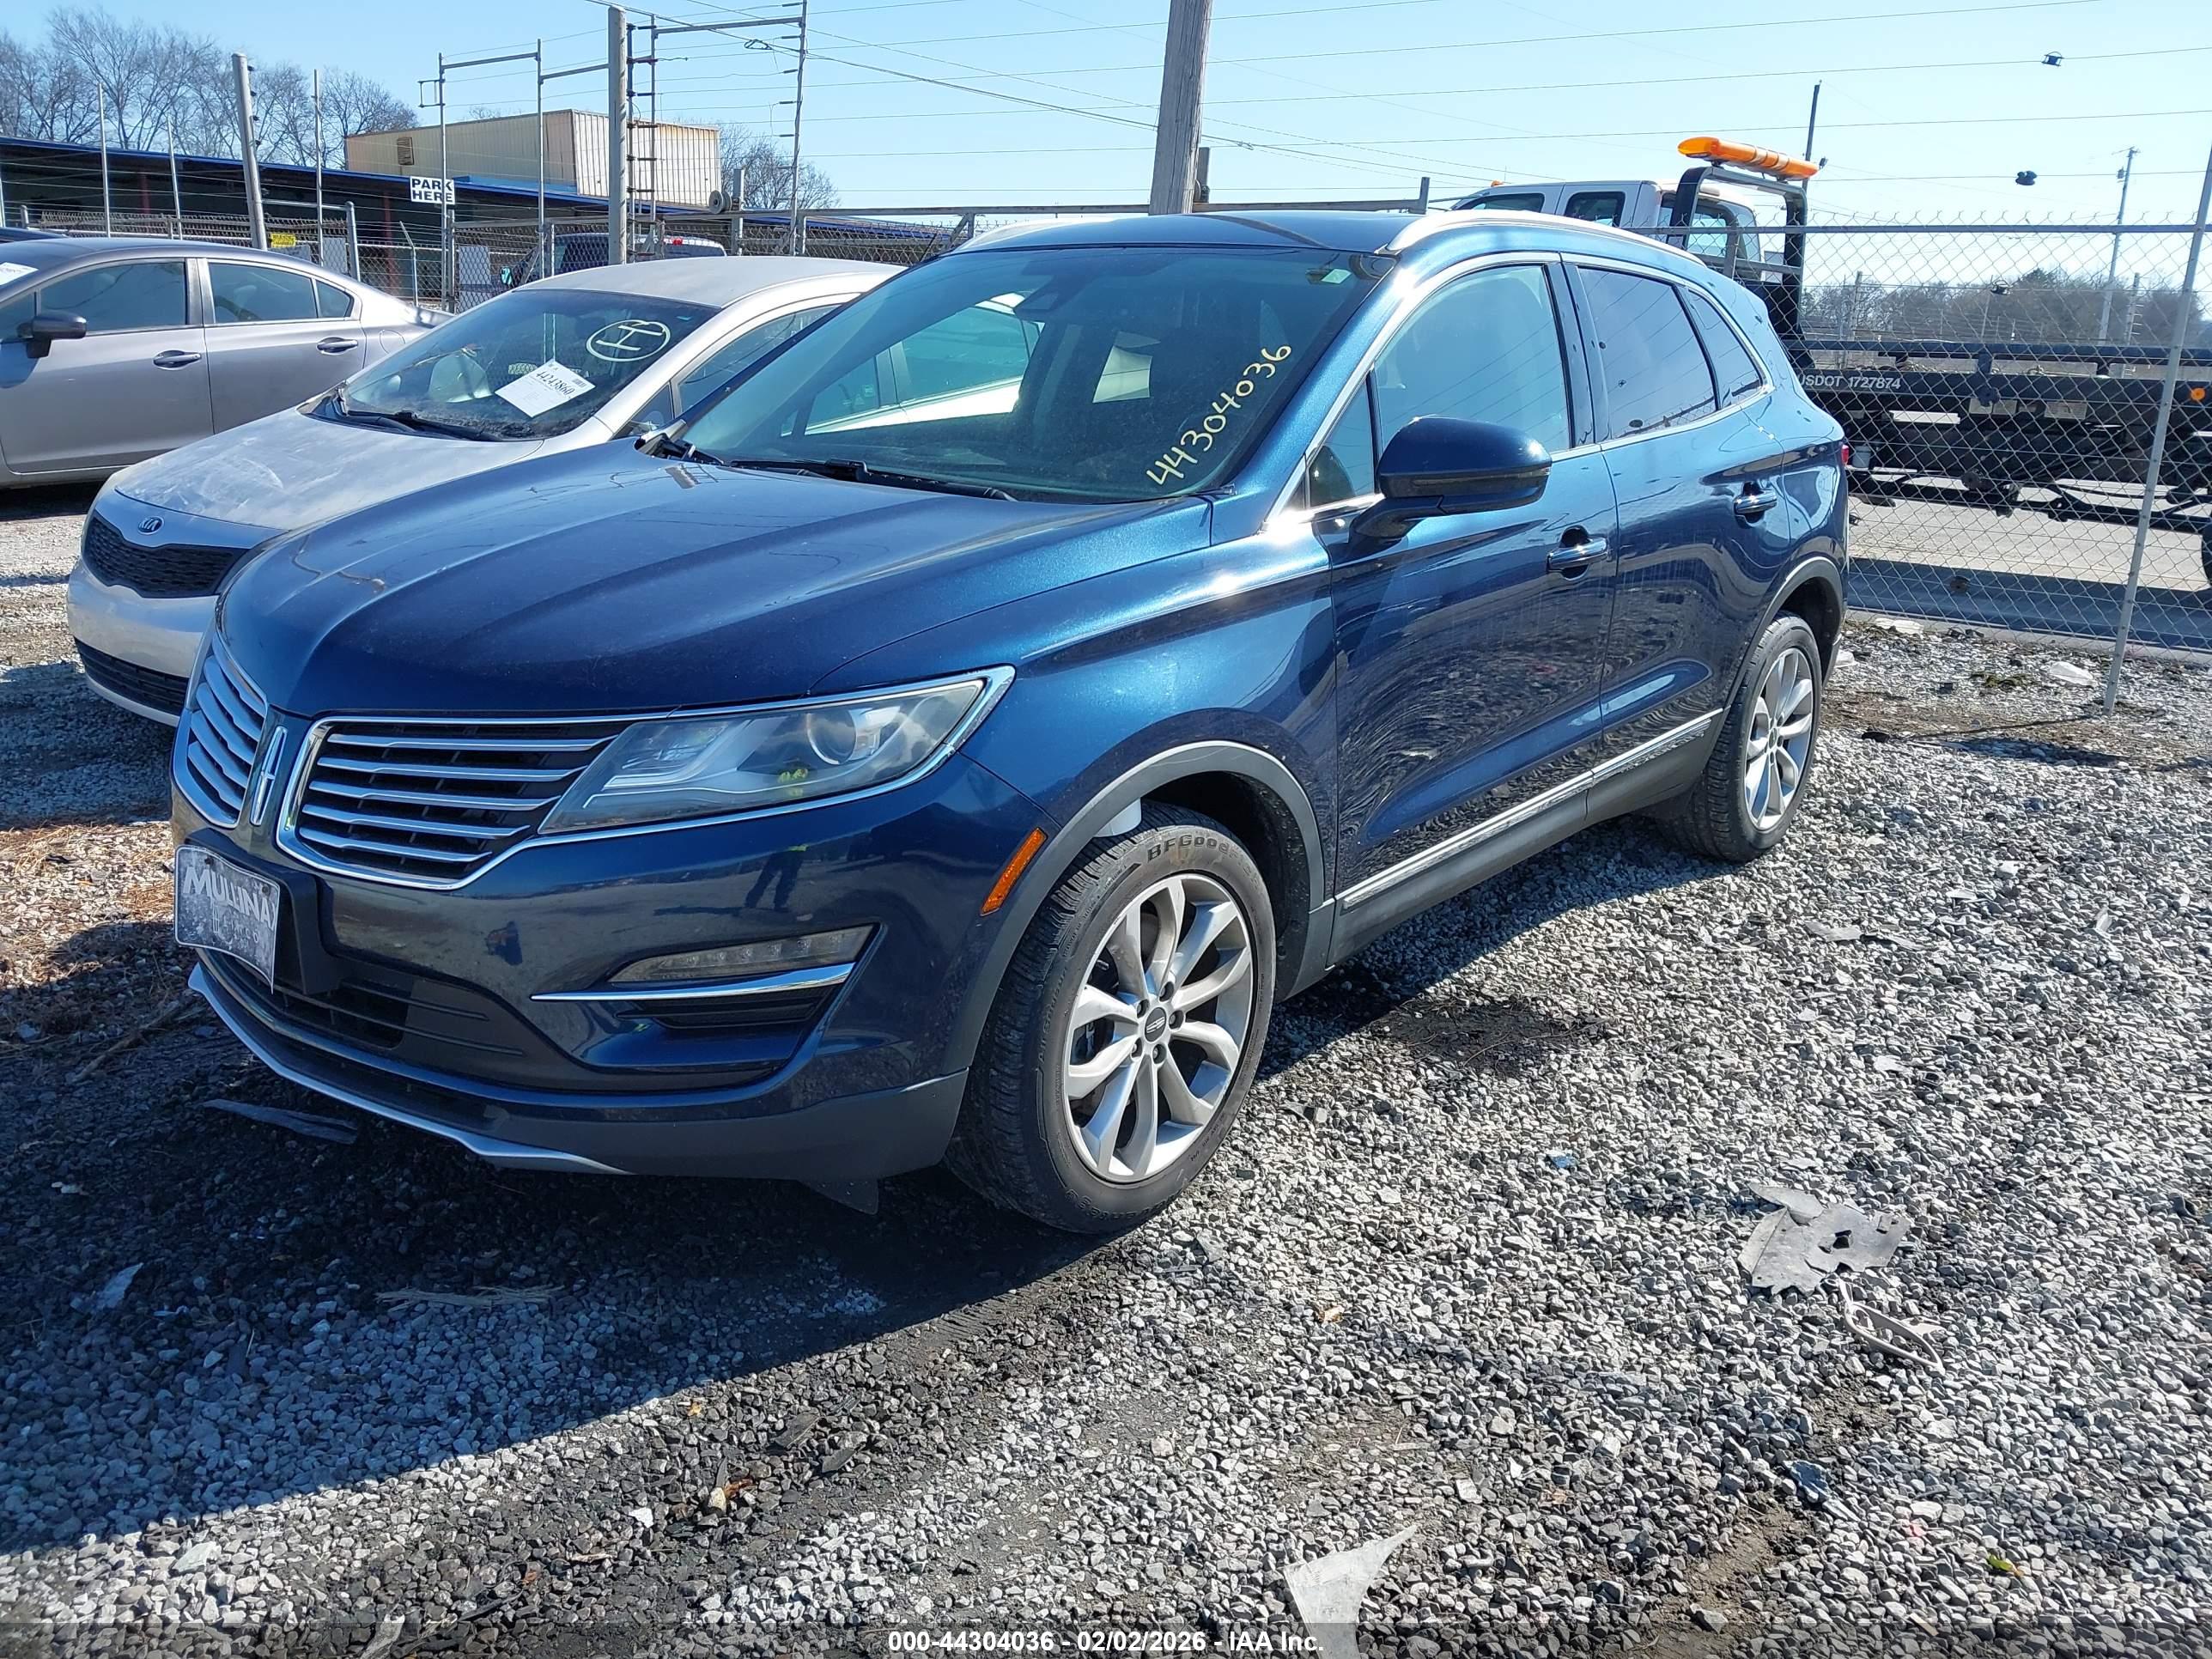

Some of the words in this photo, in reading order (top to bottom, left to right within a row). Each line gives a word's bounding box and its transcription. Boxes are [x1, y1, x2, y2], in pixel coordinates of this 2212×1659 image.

[412, 178, 453, 191] PARK
[412, 190, 453, 203] HERE
[1848, 376, 1901, 390] 1727874
[1146, 345, 1291, 485] 44304036
